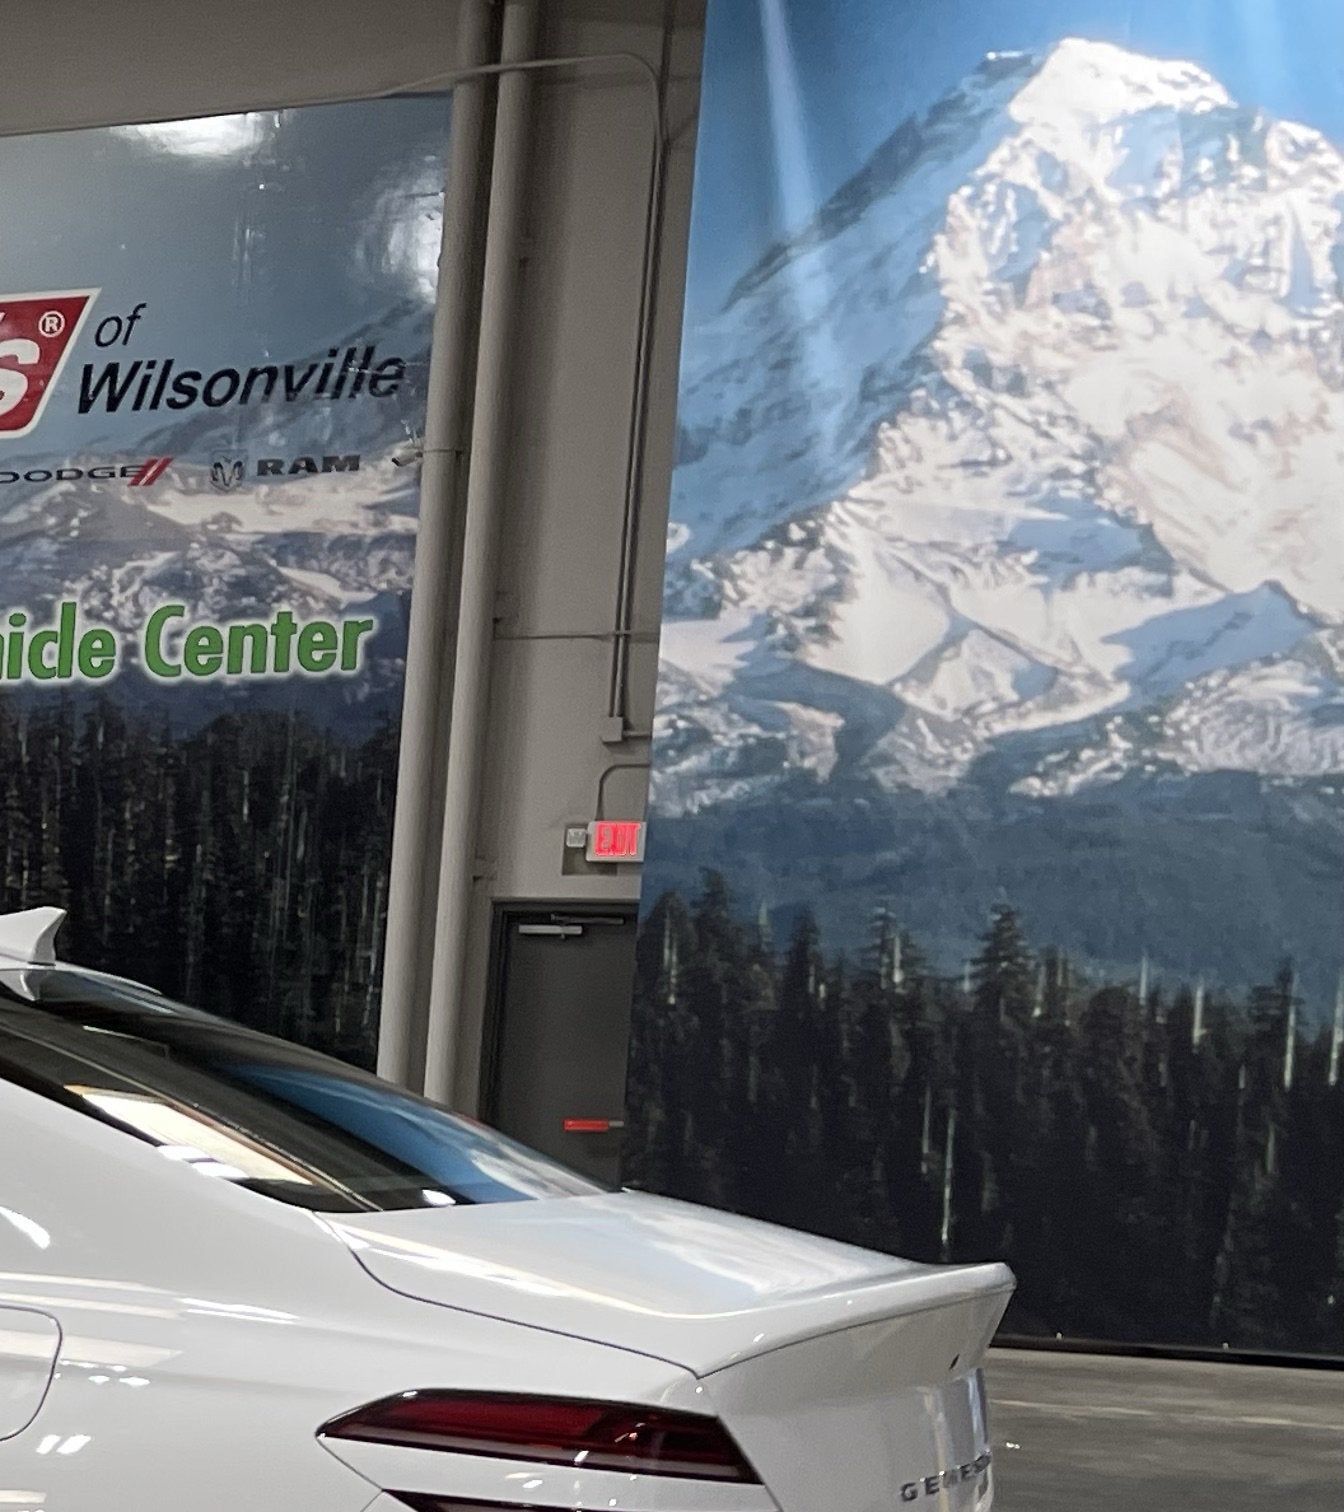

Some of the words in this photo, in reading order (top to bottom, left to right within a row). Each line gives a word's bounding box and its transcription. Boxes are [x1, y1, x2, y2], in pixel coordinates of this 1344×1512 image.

[95, 302, 148, 347] of
[77, 345, 408, 415] Wilsonville
[256, 454, 361, 477] RAM
[145, 605, 374, 676] Center
